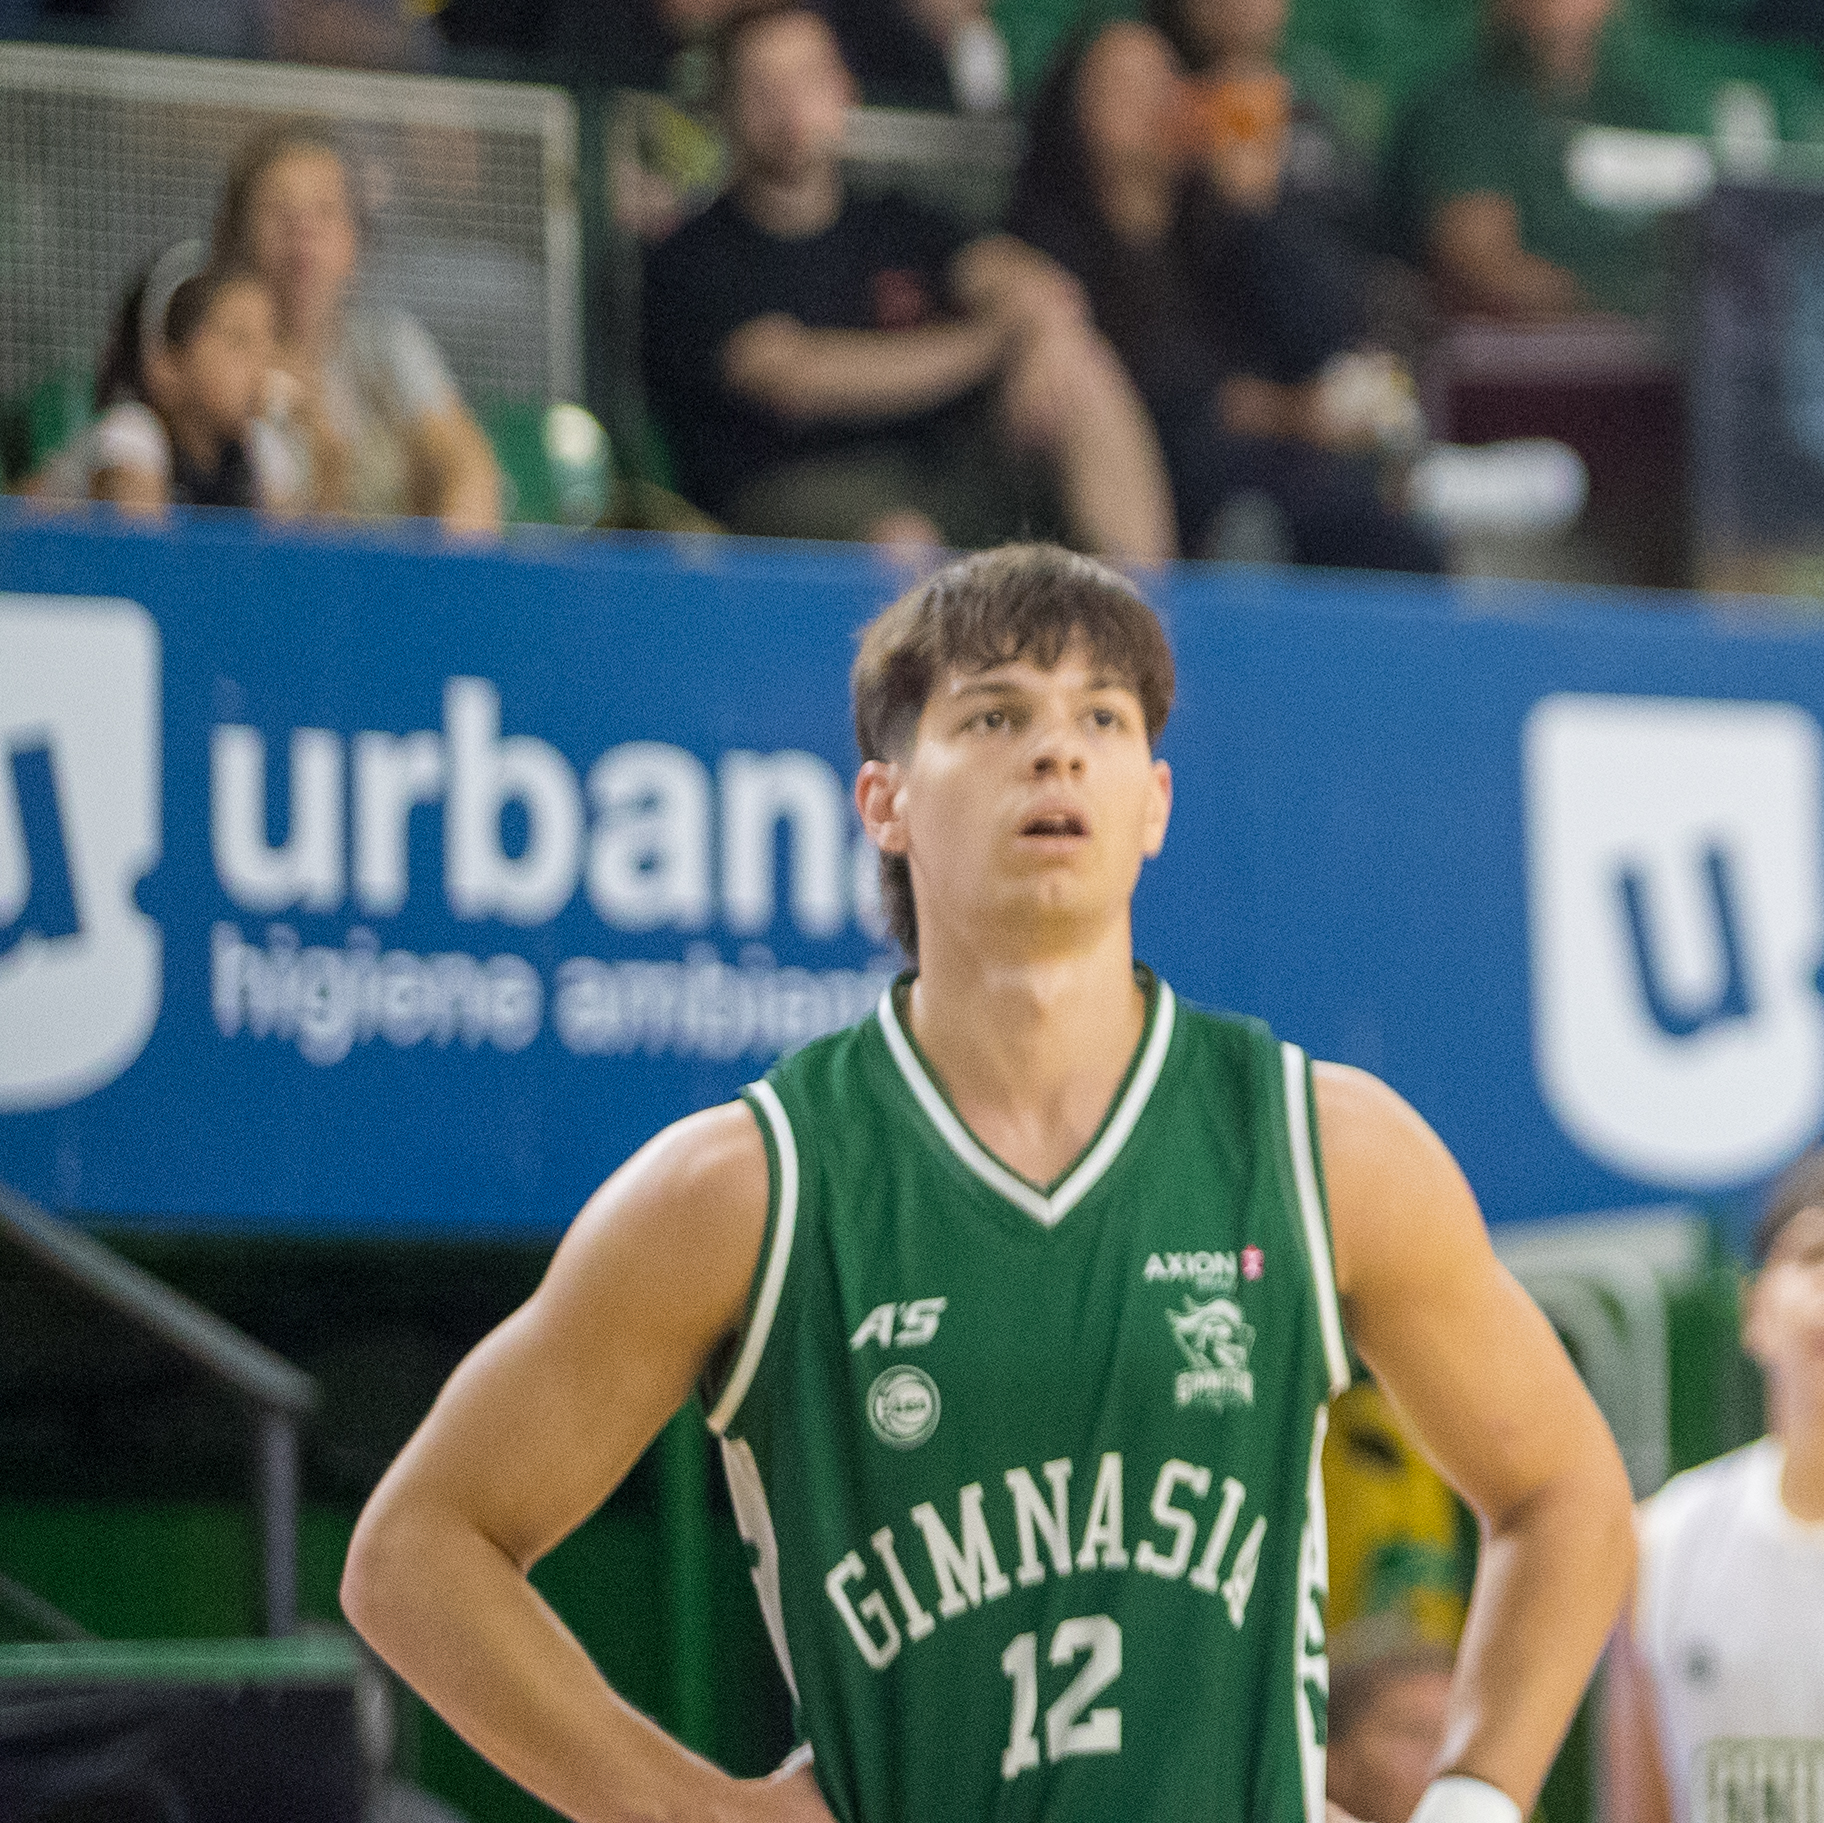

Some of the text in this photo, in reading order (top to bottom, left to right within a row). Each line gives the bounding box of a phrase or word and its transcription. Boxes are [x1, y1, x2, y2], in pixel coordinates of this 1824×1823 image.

[210, 676, 890, 941] urban
[824, 1451, 1267, 1669] GIMNASIA
[1001, 1614, 1122, 1780] 12
